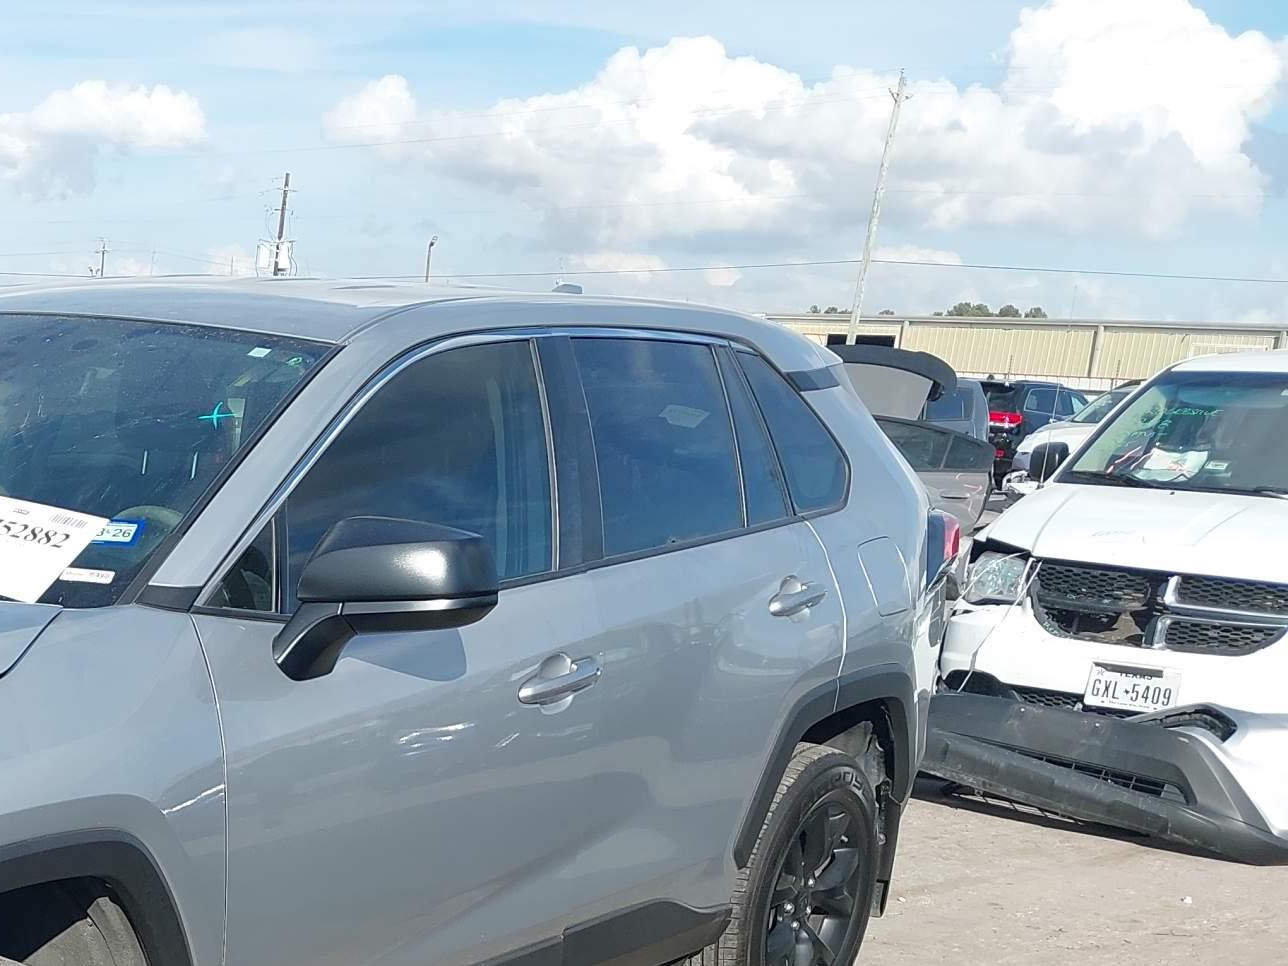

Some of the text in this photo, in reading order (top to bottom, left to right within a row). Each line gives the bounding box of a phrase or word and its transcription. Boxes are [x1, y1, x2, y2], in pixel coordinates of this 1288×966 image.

[111, 527, 133, 538] 26
[1091, 678, 1172, 707] GXL 5409
